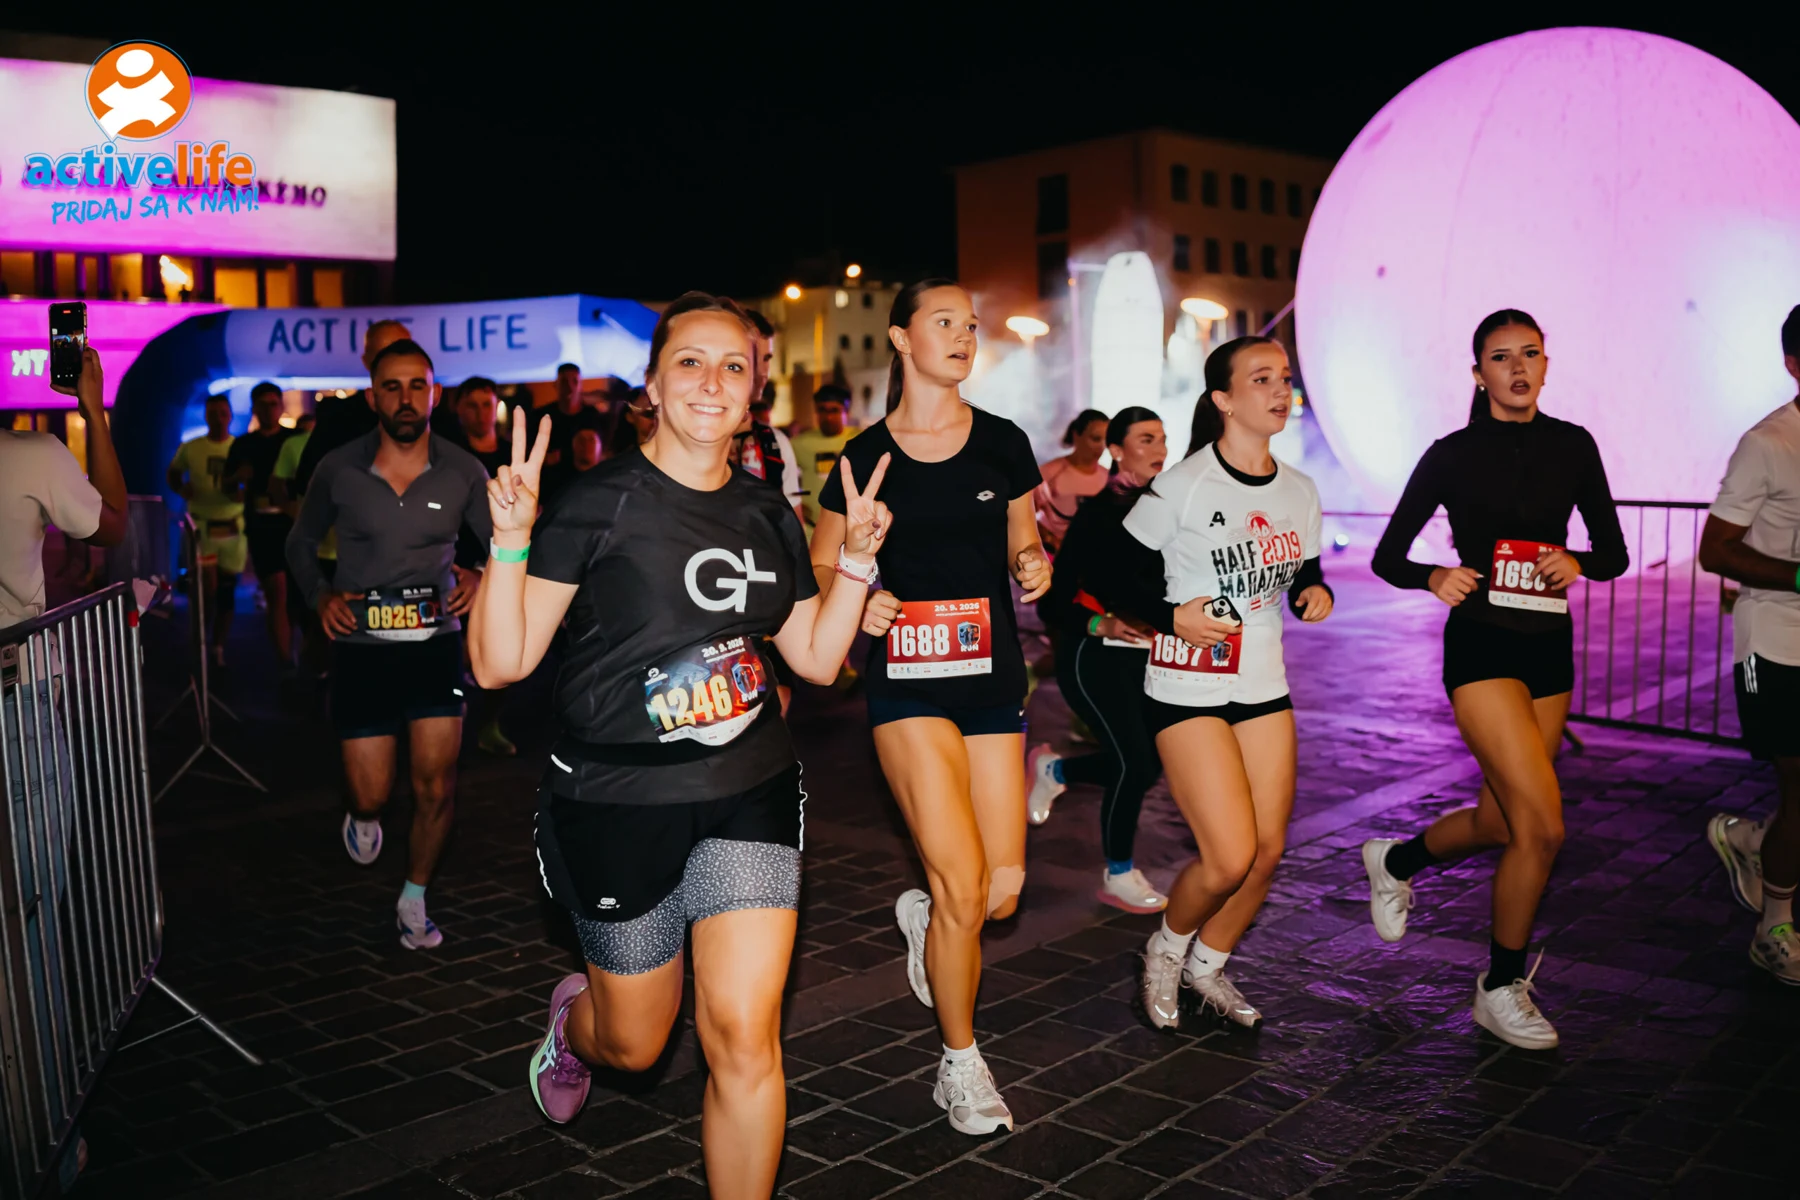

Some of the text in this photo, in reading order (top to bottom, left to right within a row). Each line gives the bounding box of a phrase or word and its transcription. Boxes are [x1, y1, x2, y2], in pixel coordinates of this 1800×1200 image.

[268, 313, 530, 354] ACTI LIFE
[1211, 530, 1302, 576] HALF 2019
[367, 604, 419, 629] 0925
[889, 624, 951, 657] 1688
[1154, 633, 1203, 667] 1687
[651, 674, 733, 731] 1246
